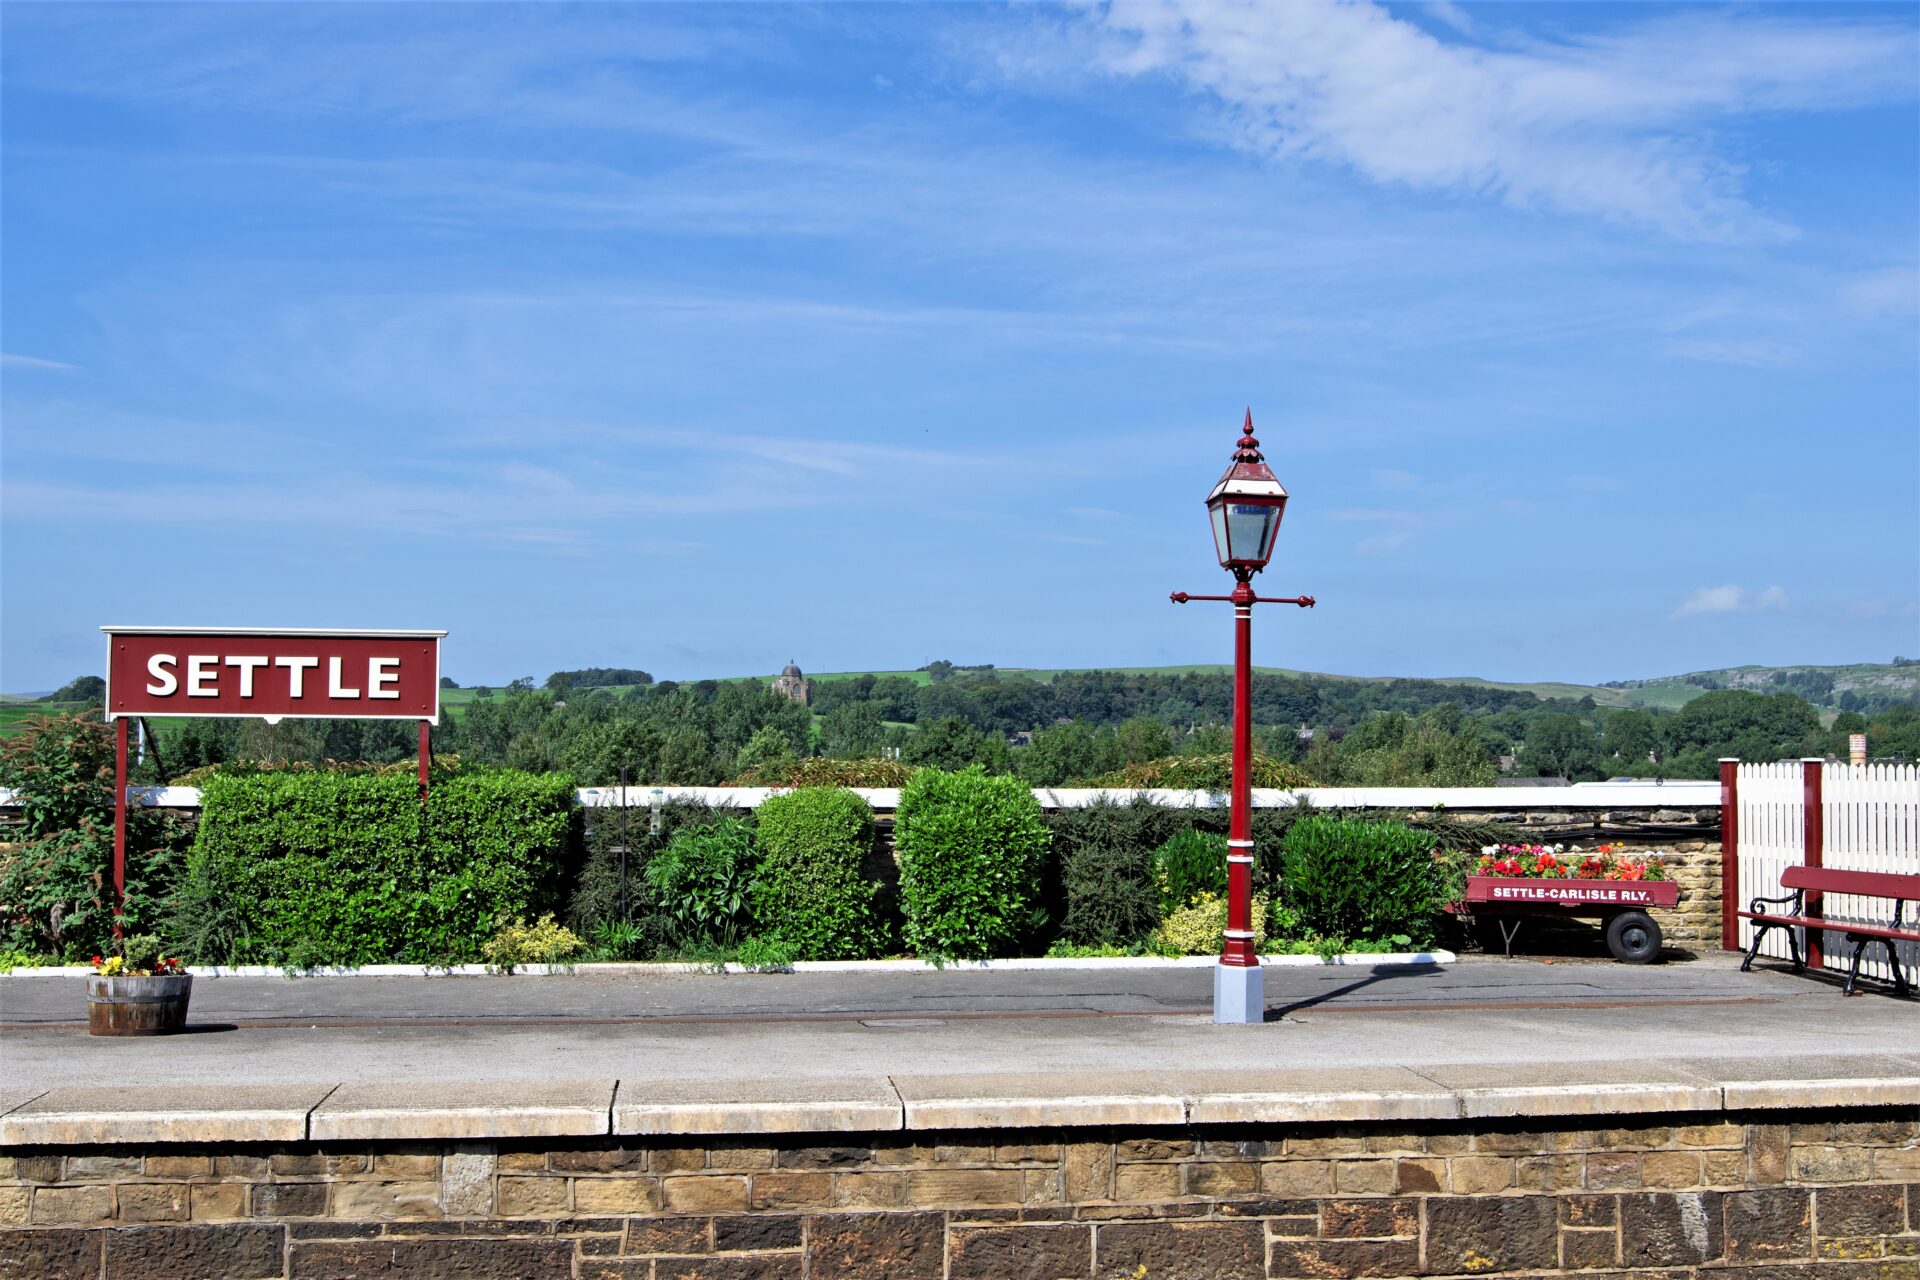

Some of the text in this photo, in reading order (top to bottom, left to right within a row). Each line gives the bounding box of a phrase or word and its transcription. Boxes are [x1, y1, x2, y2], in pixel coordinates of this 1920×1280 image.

[146, 653, 401, 699] SETTLE
[1493, 888, 1650, 901] SETTLE-CARLISLE RLY.
